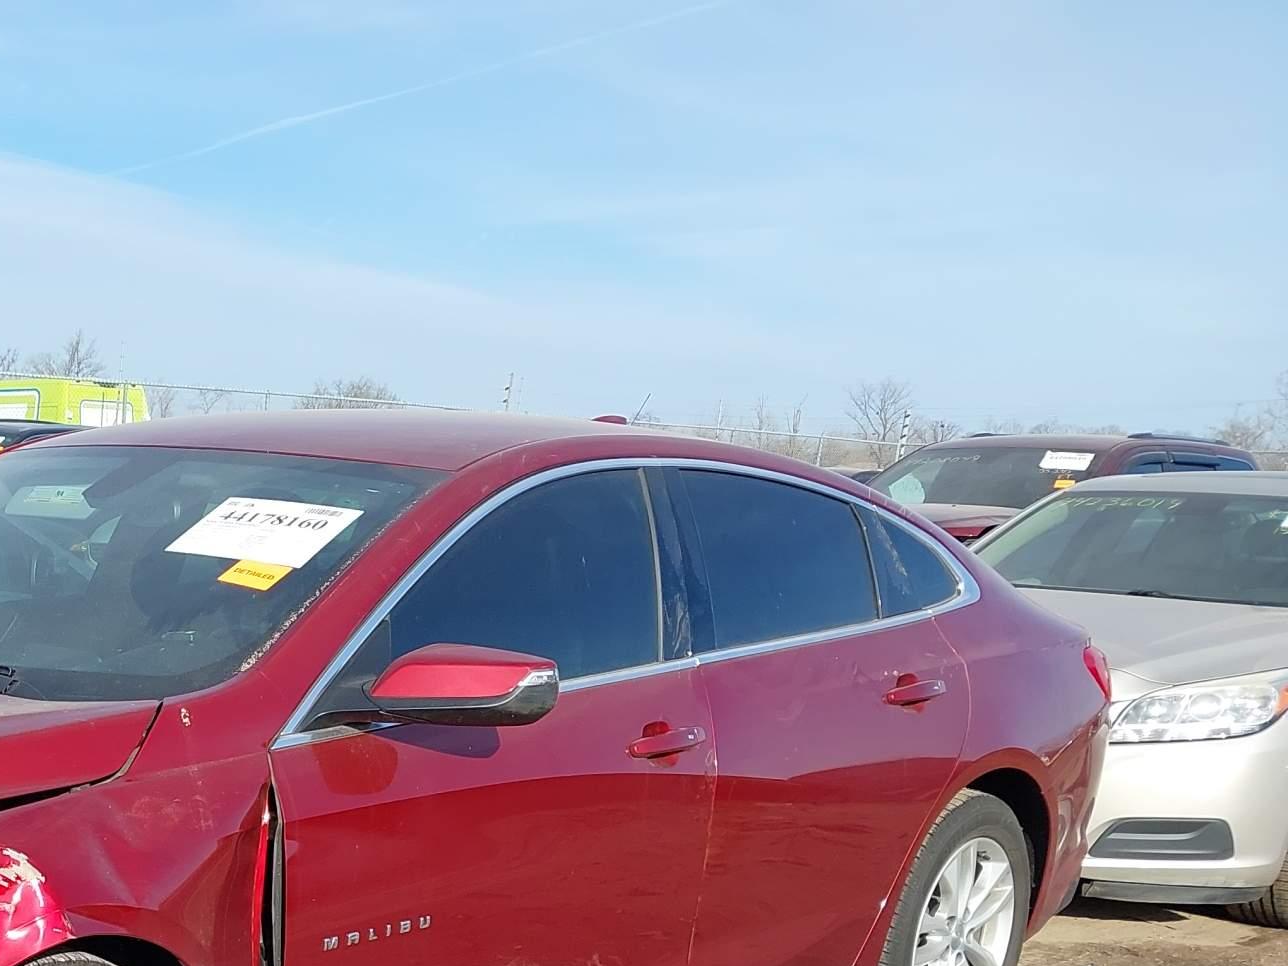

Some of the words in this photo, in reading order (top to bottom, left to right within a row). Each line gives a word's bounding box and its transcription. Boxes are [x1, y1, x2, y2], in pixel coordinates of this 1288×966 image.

[219, 510, 329, 531] 44178160
[233, 567, 275, 581] DETAILED
[322, 915, 432, 952] MALIBU
